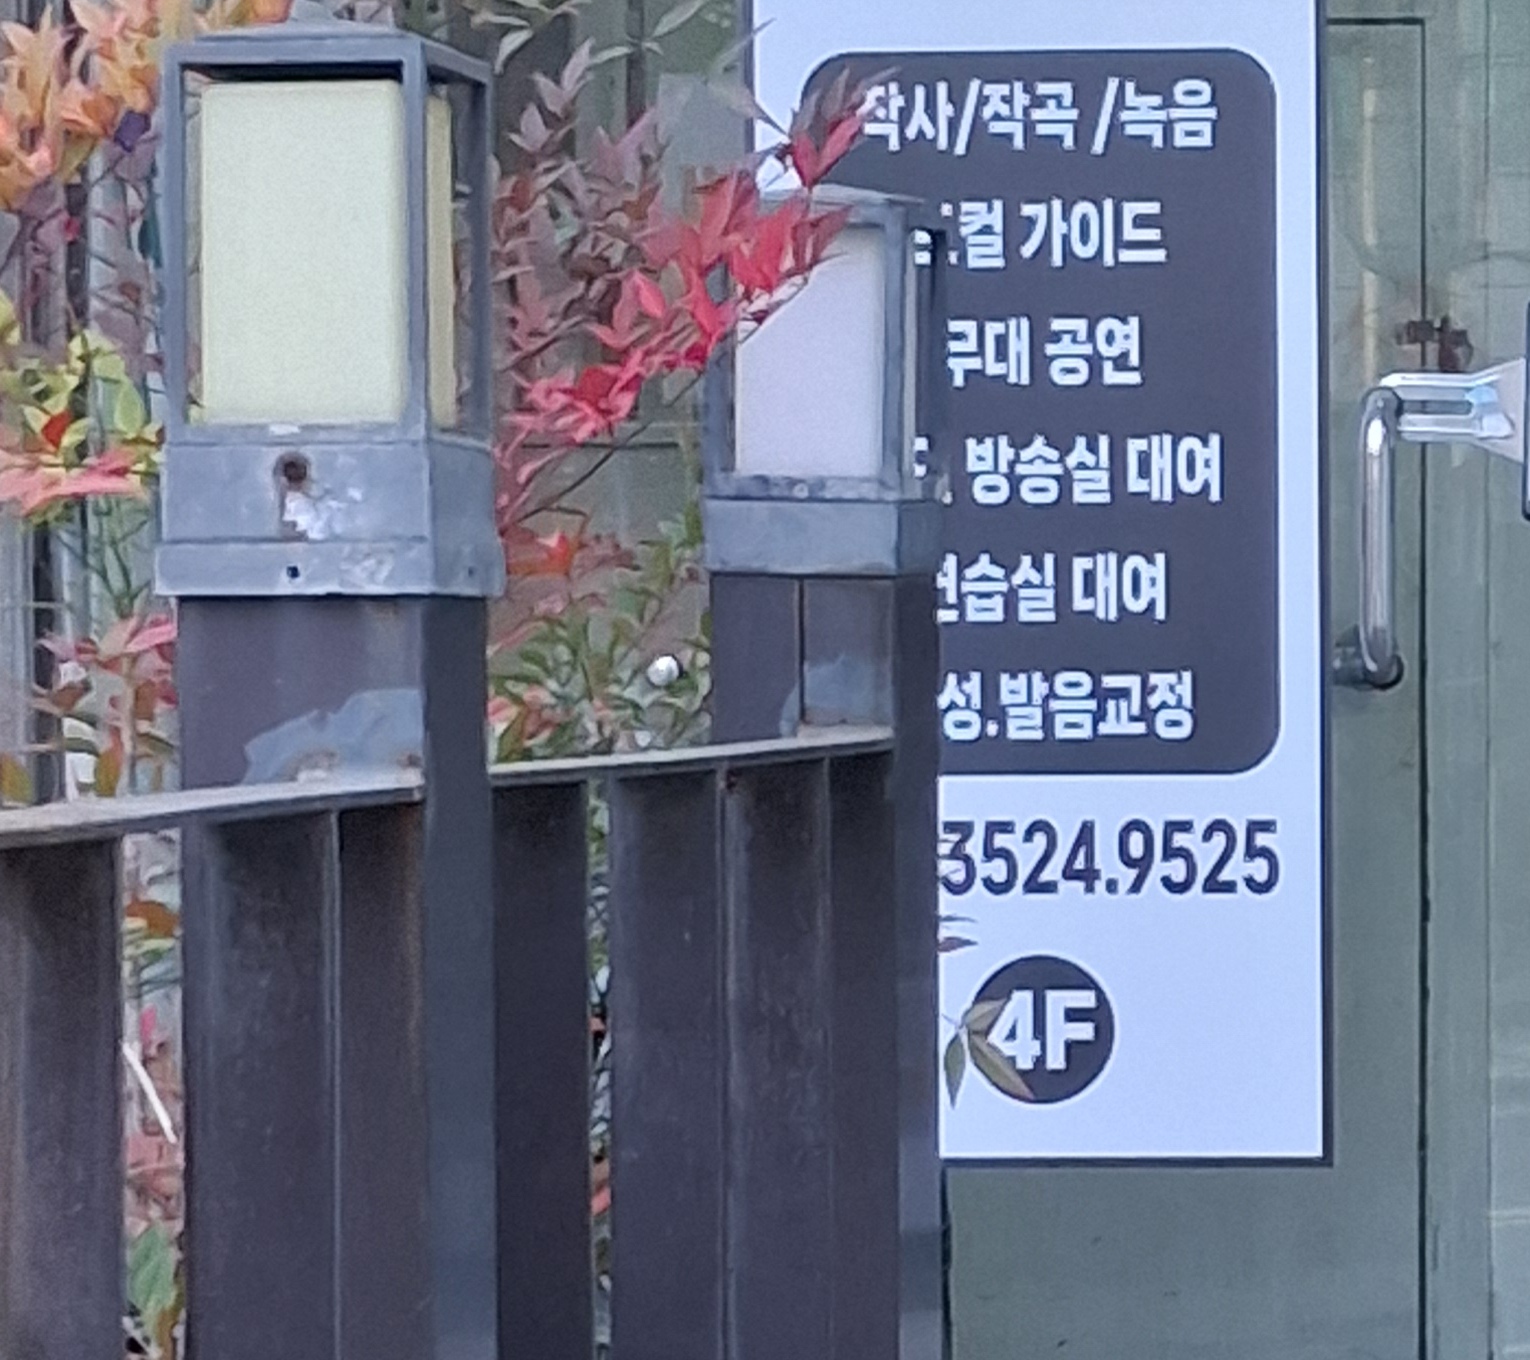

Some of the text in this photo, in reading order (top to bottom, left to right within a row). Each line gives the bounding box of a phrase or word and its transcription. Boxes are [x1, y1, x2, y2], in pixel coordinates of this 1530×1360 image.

[862, 77, 1080, 157] 작사/작곡
[939, 197, 1167, 270] 컬 가이드
[1044, 316, 1142, 386] 공연
[965, 434, 1111, 504] 방송실
[1126, 433, 1221, 502] 대여
[1072, 552, 1166, 621] 대여
[938, 668, 1196, 742] 성.발음교정
[940, 819, 1281, 895] 3524.9525
[986, 989, 1098, 1072] 4F
